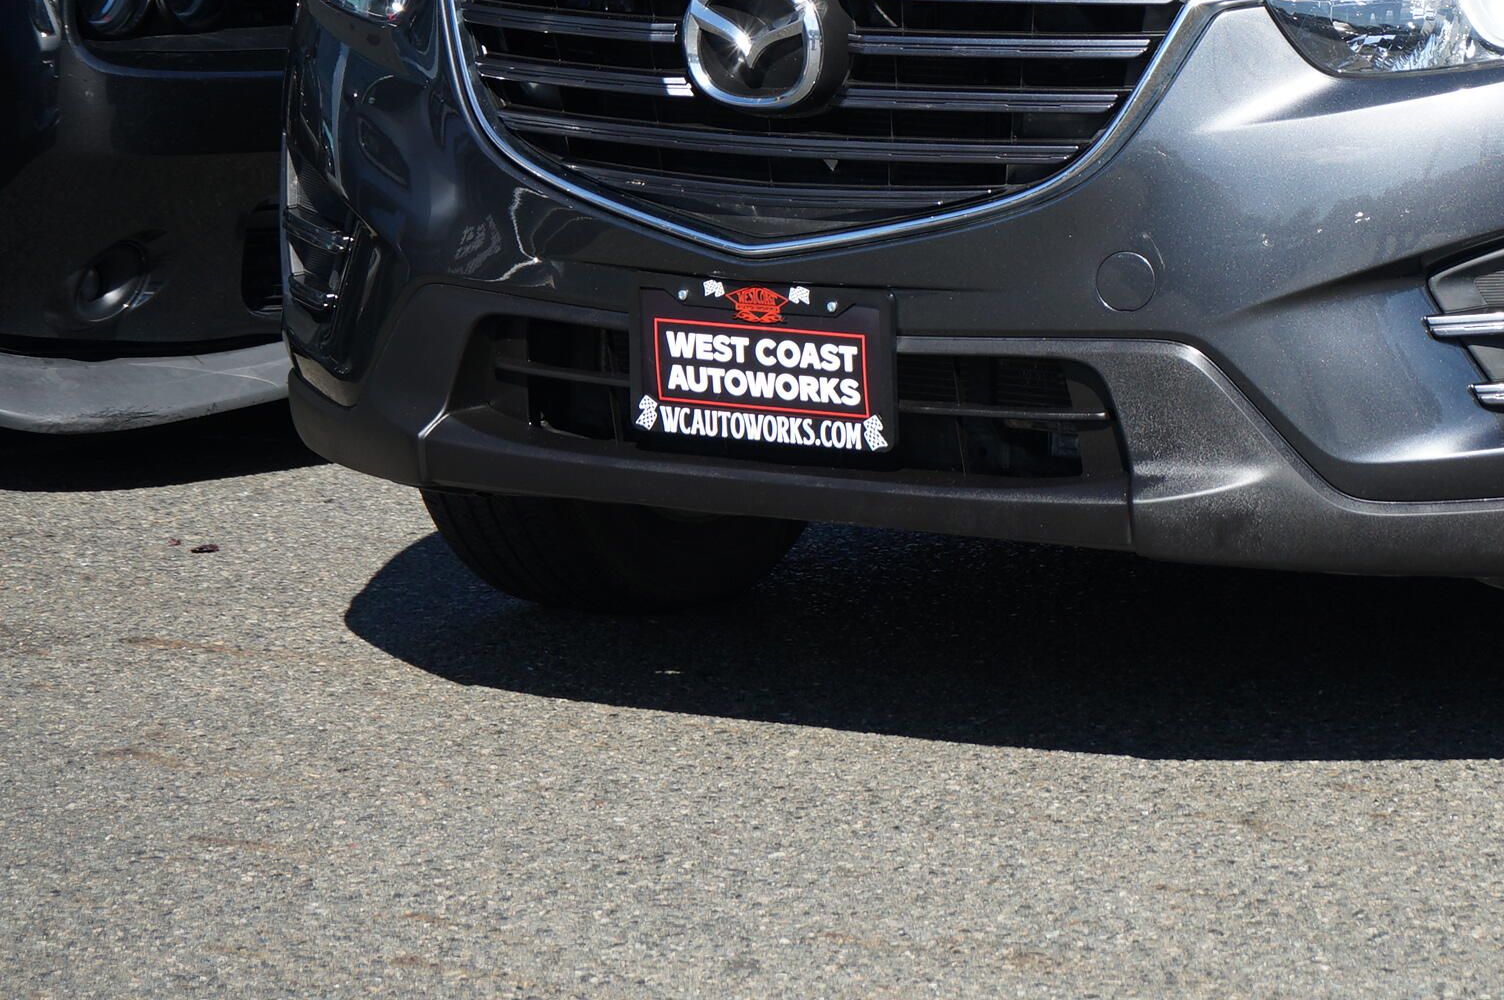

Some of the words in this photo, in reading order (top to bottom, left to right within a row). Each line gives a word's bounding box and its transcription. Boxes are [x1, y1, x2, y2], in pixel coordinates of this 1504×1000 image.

[665, 330, 749, 364] WEST
[755, 338, 858, 372] COAST
[667, 365, 861, 406] AUTOWORKS
[660, 406, 863, 450] WCAUTOWORKS.COM
